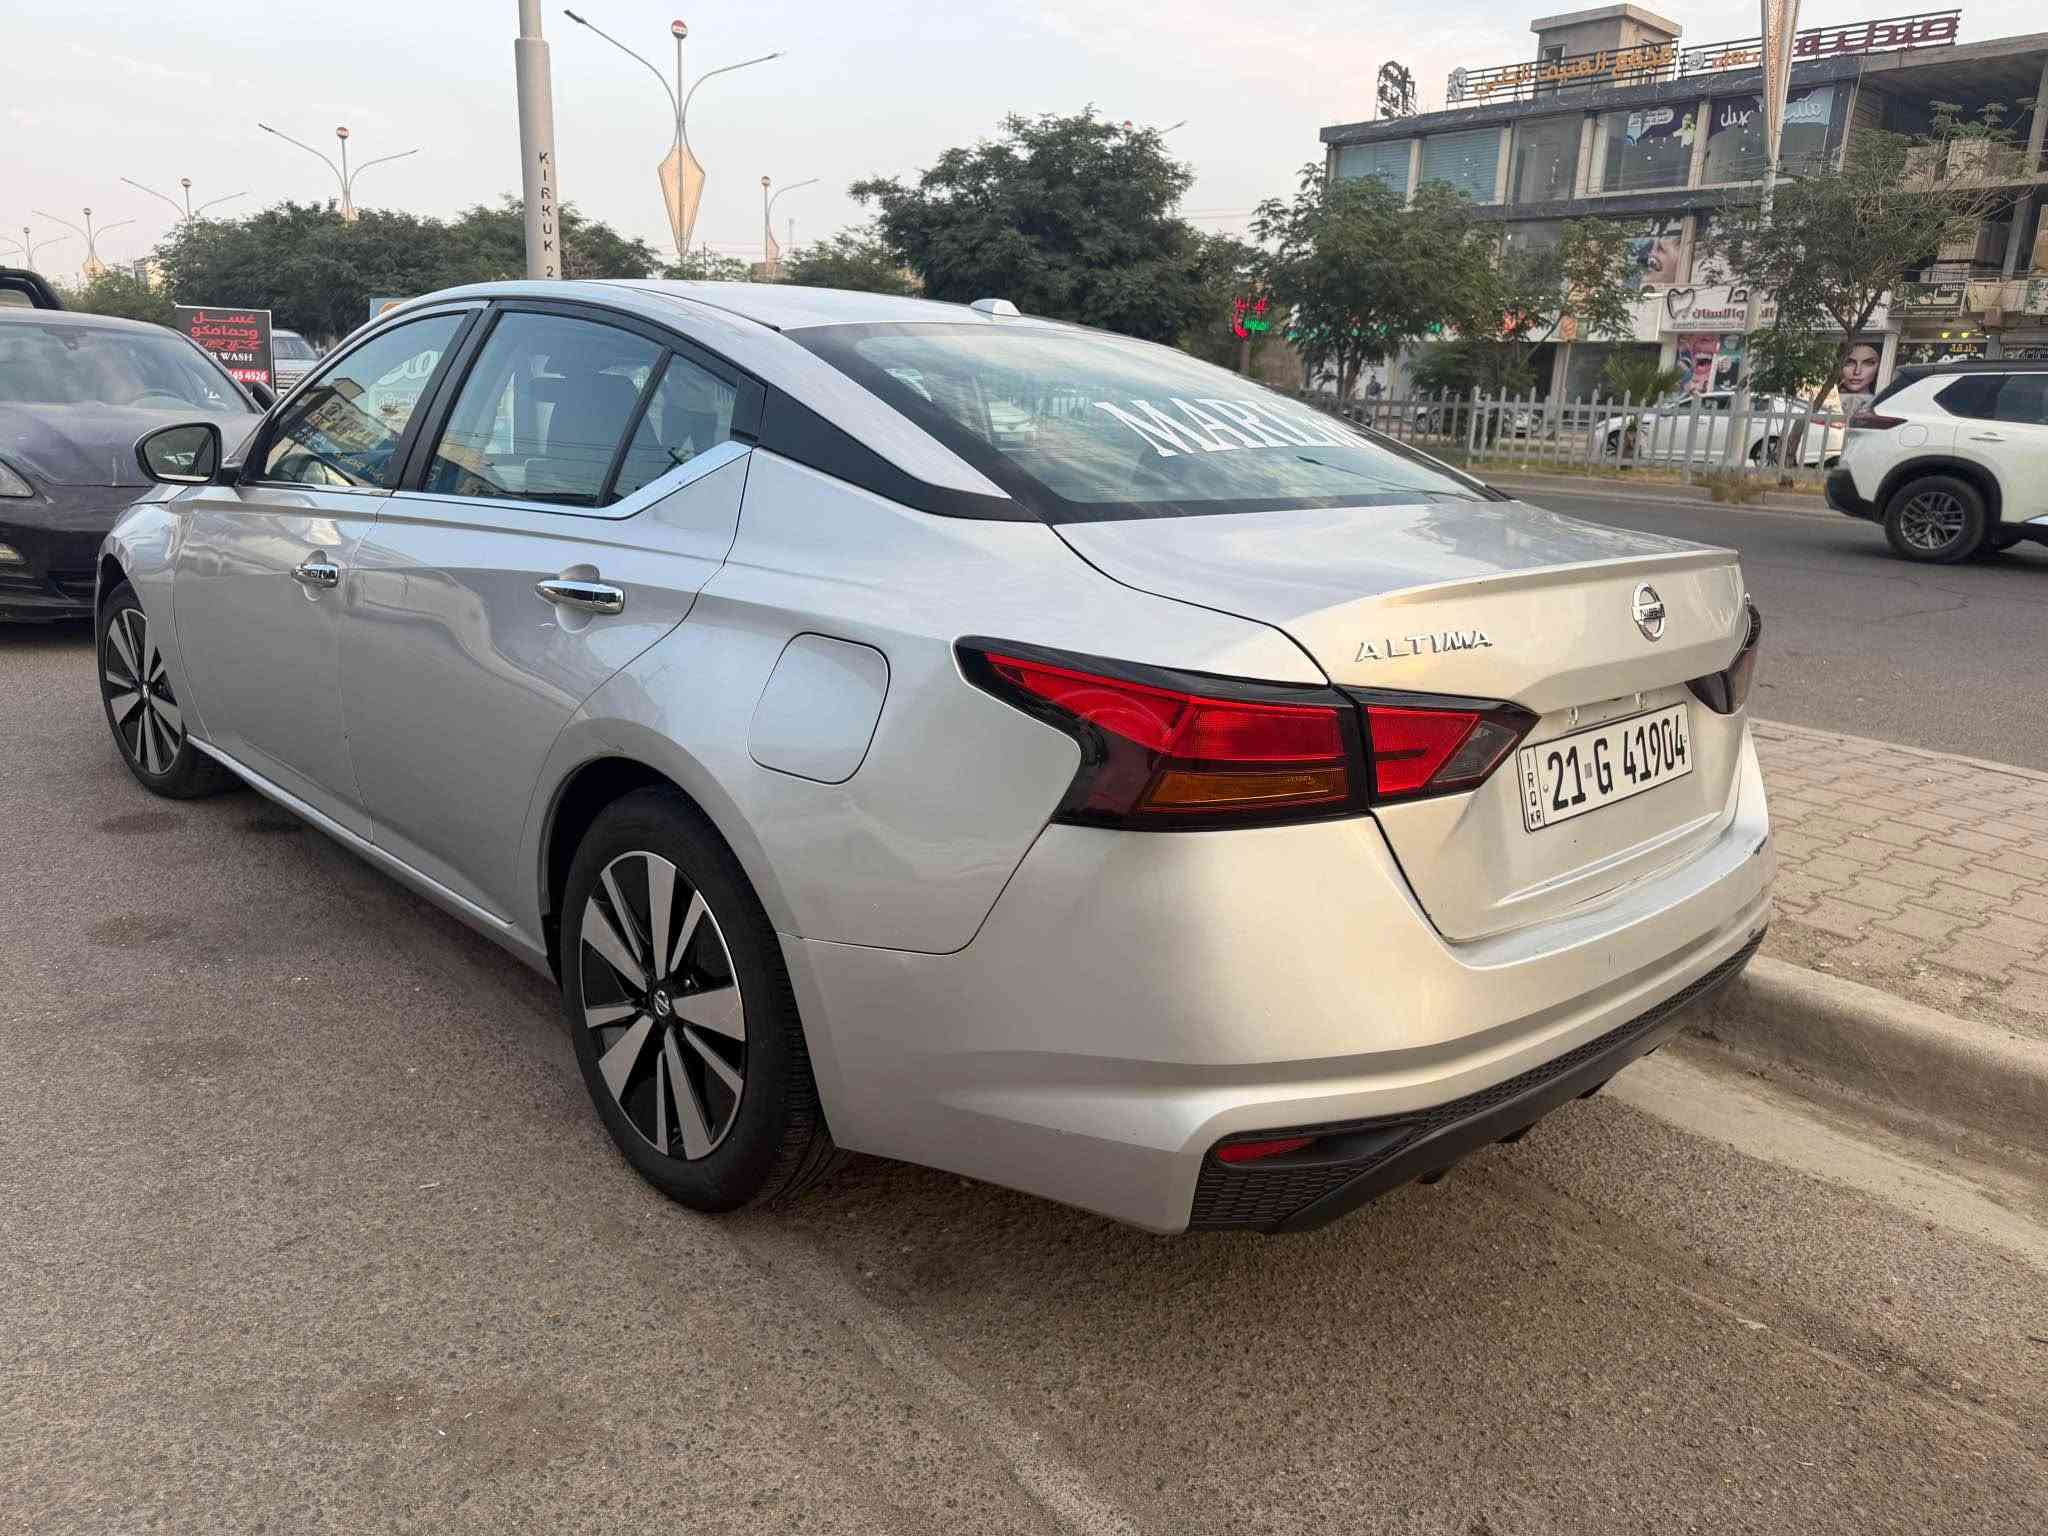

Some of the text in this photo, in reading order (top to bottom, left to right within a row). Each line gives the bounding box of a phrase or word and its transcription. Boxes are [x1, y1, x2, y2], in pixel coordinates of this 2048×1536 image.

[538, 151, 553, 253] KIRKUK
[221, 352, 253, 362] WASH
[1355, 629, 1493, 663] ALTIMA
[1526, 753, 1538, 807] IRQ
[1547, 714, 1686, 811] 21 G 41904
[1529, 809, 1542, 825] KR
